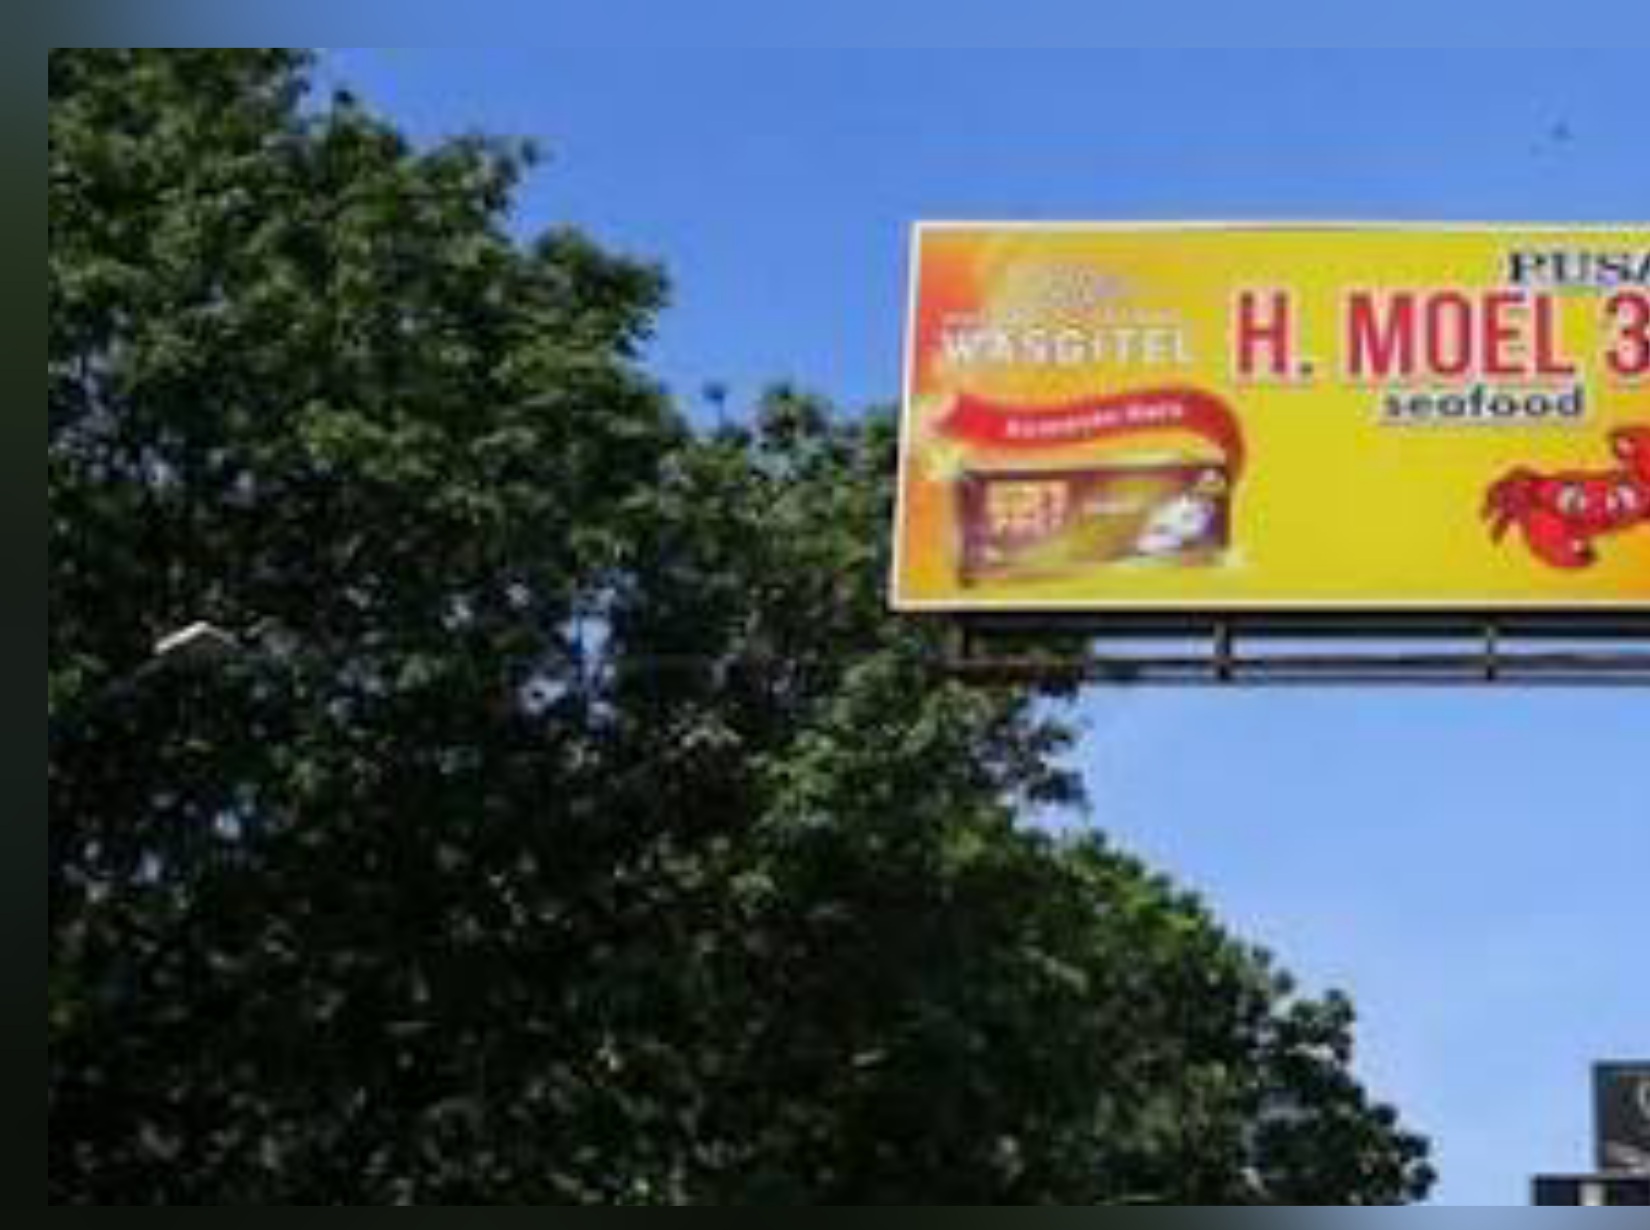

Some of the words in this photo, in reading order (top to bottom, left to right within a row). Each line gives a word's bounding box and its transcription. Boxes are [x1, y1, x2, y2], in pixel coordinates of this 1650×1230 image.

[1236, 292, 1314, 376] H.
[1347, 292, 1577, 376] MOEL
[1386, 384, 1584, 418] seafood
